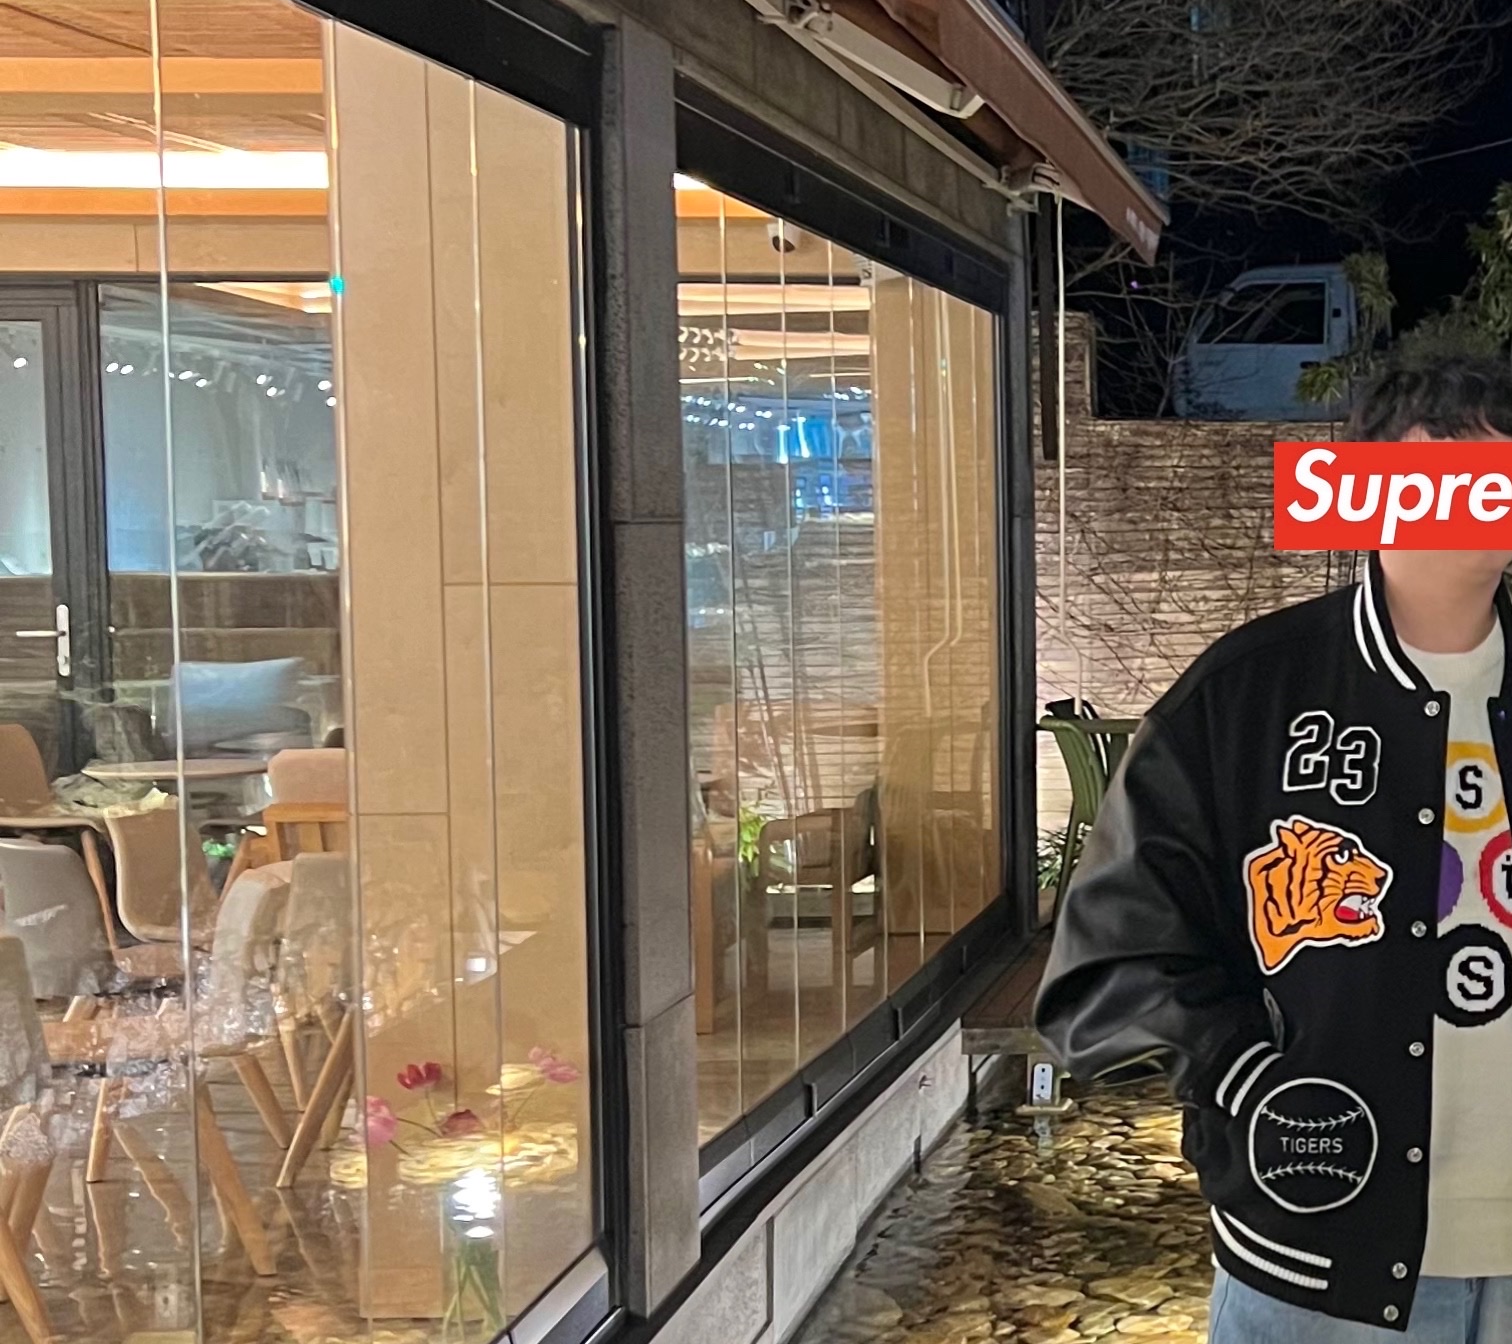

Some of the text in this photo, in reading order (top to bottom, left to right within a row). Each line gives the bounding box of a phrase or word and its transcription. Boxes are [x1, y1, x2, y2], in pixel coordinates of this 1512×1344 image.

[1282, 710, 1381, 805] 23
[1455, 765, 1483, 810] S
[1457, 955, 1494, 1000] S
[1280, 1137, 1343, 1153] TIGERS
